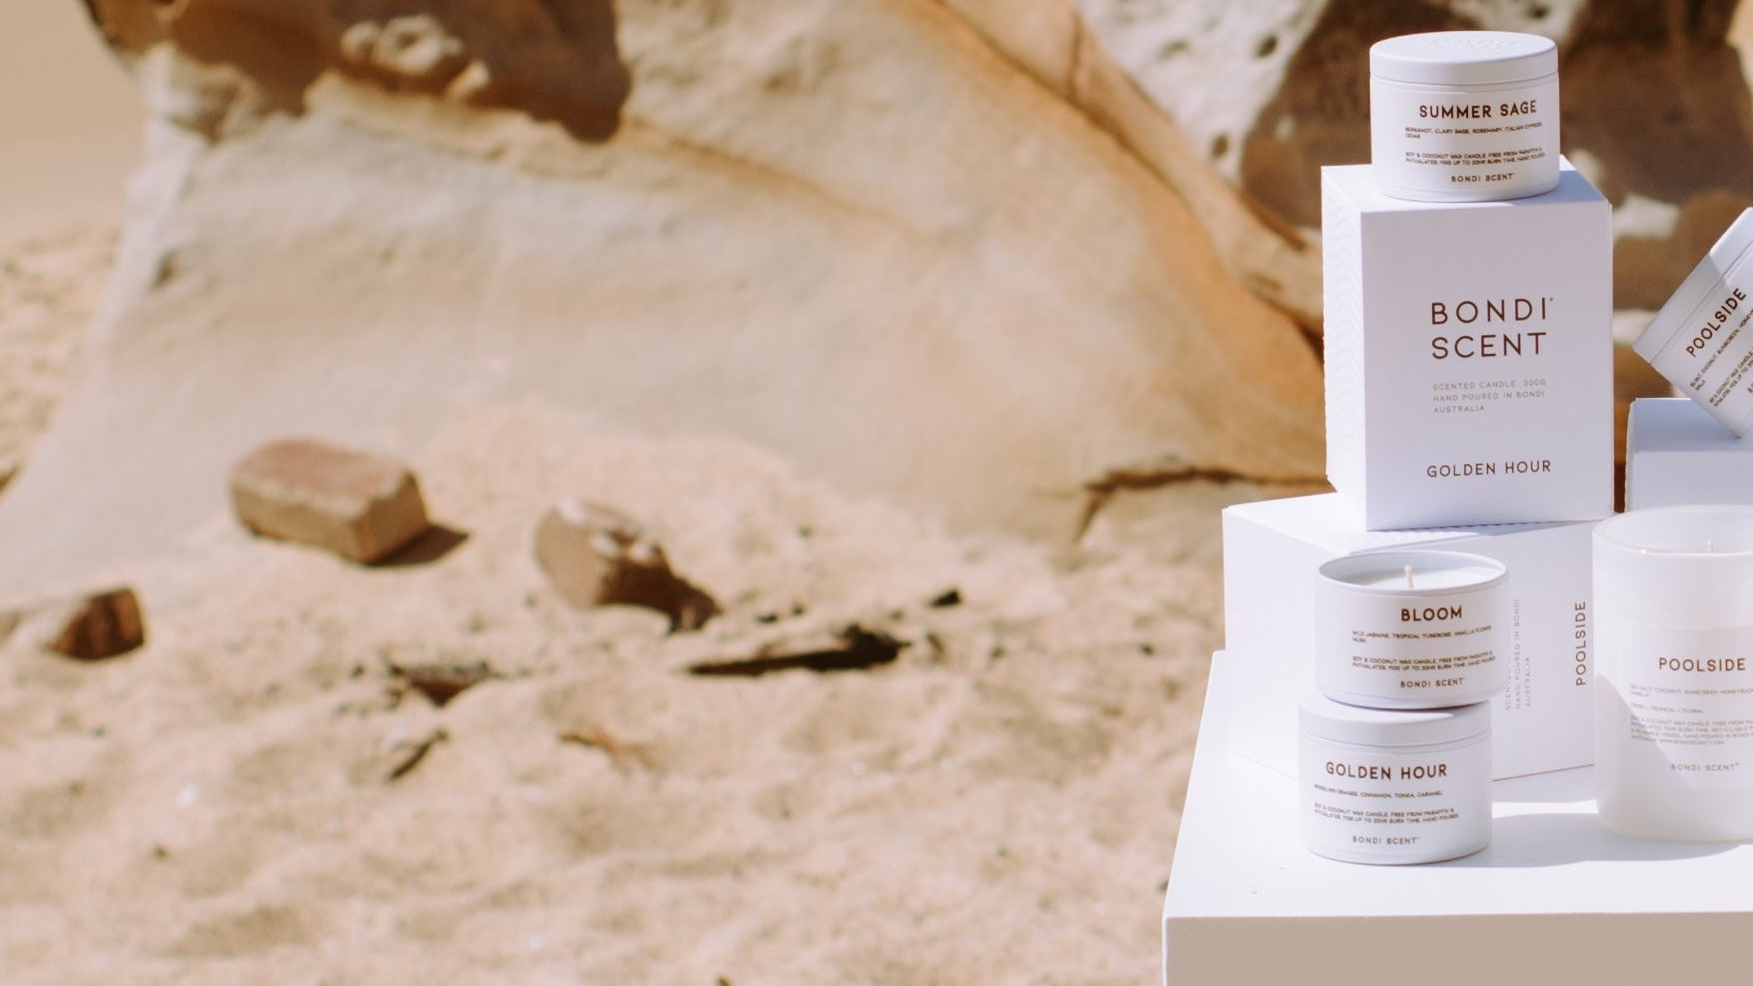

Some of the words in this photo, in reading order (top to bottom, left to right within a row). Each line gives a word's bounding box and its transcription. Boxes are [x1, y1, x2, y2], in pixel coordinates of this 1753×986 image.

[1419, 104, 1492, 119] SUMMER
[1500, 99, 1537, 116] SAGE
[1685, 288, 1747, 358] POOLSIDE
[1431, 332, 1546, 359] SCENT
[1432, 394, 1458, 402] HAND
[1462, 392, 1499, 401] POURED
[1503, 391, 1512, 399] IN
[1427, 462, 1496, 478] GOLDEN
[1505, 460, 1552, 475] HOUR
[1401, 606, 1463, 622] BLOOM
[1575, 601, 1587, 686] POOLSIDE
[1658, 657, 1746, 672] POOLSIDE
[1400, 680, 1431, 688] BONDI
[1325, 761, 1392, 780] GOLDEN
[1400, 763, 1448, 780] HOUR
